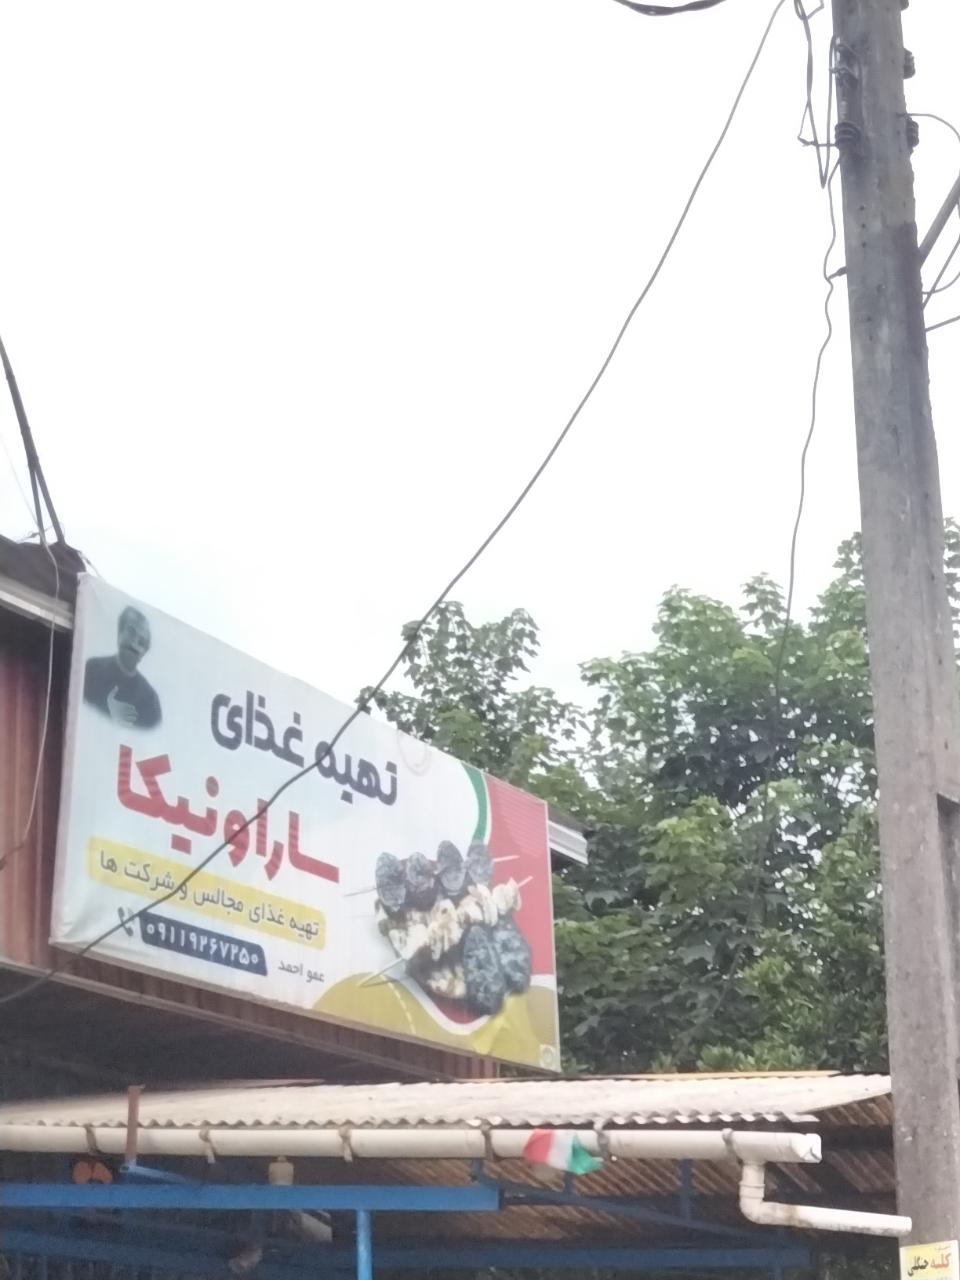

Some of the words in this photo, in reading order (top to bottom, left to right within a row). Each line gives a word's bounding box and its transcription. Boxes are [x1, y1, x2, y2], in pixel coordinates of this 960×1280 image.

[211, 690, 304, 769] غذای
[315, 741, 398, 806] تهیه
[124, 860, 175, 892] شرکت
[193, 887, 244, 914] مجالس
[250, 902, 285, 926] غذای
[289, 917, 319, 941] تهیه
[277, 959, 304, 977] احمد
